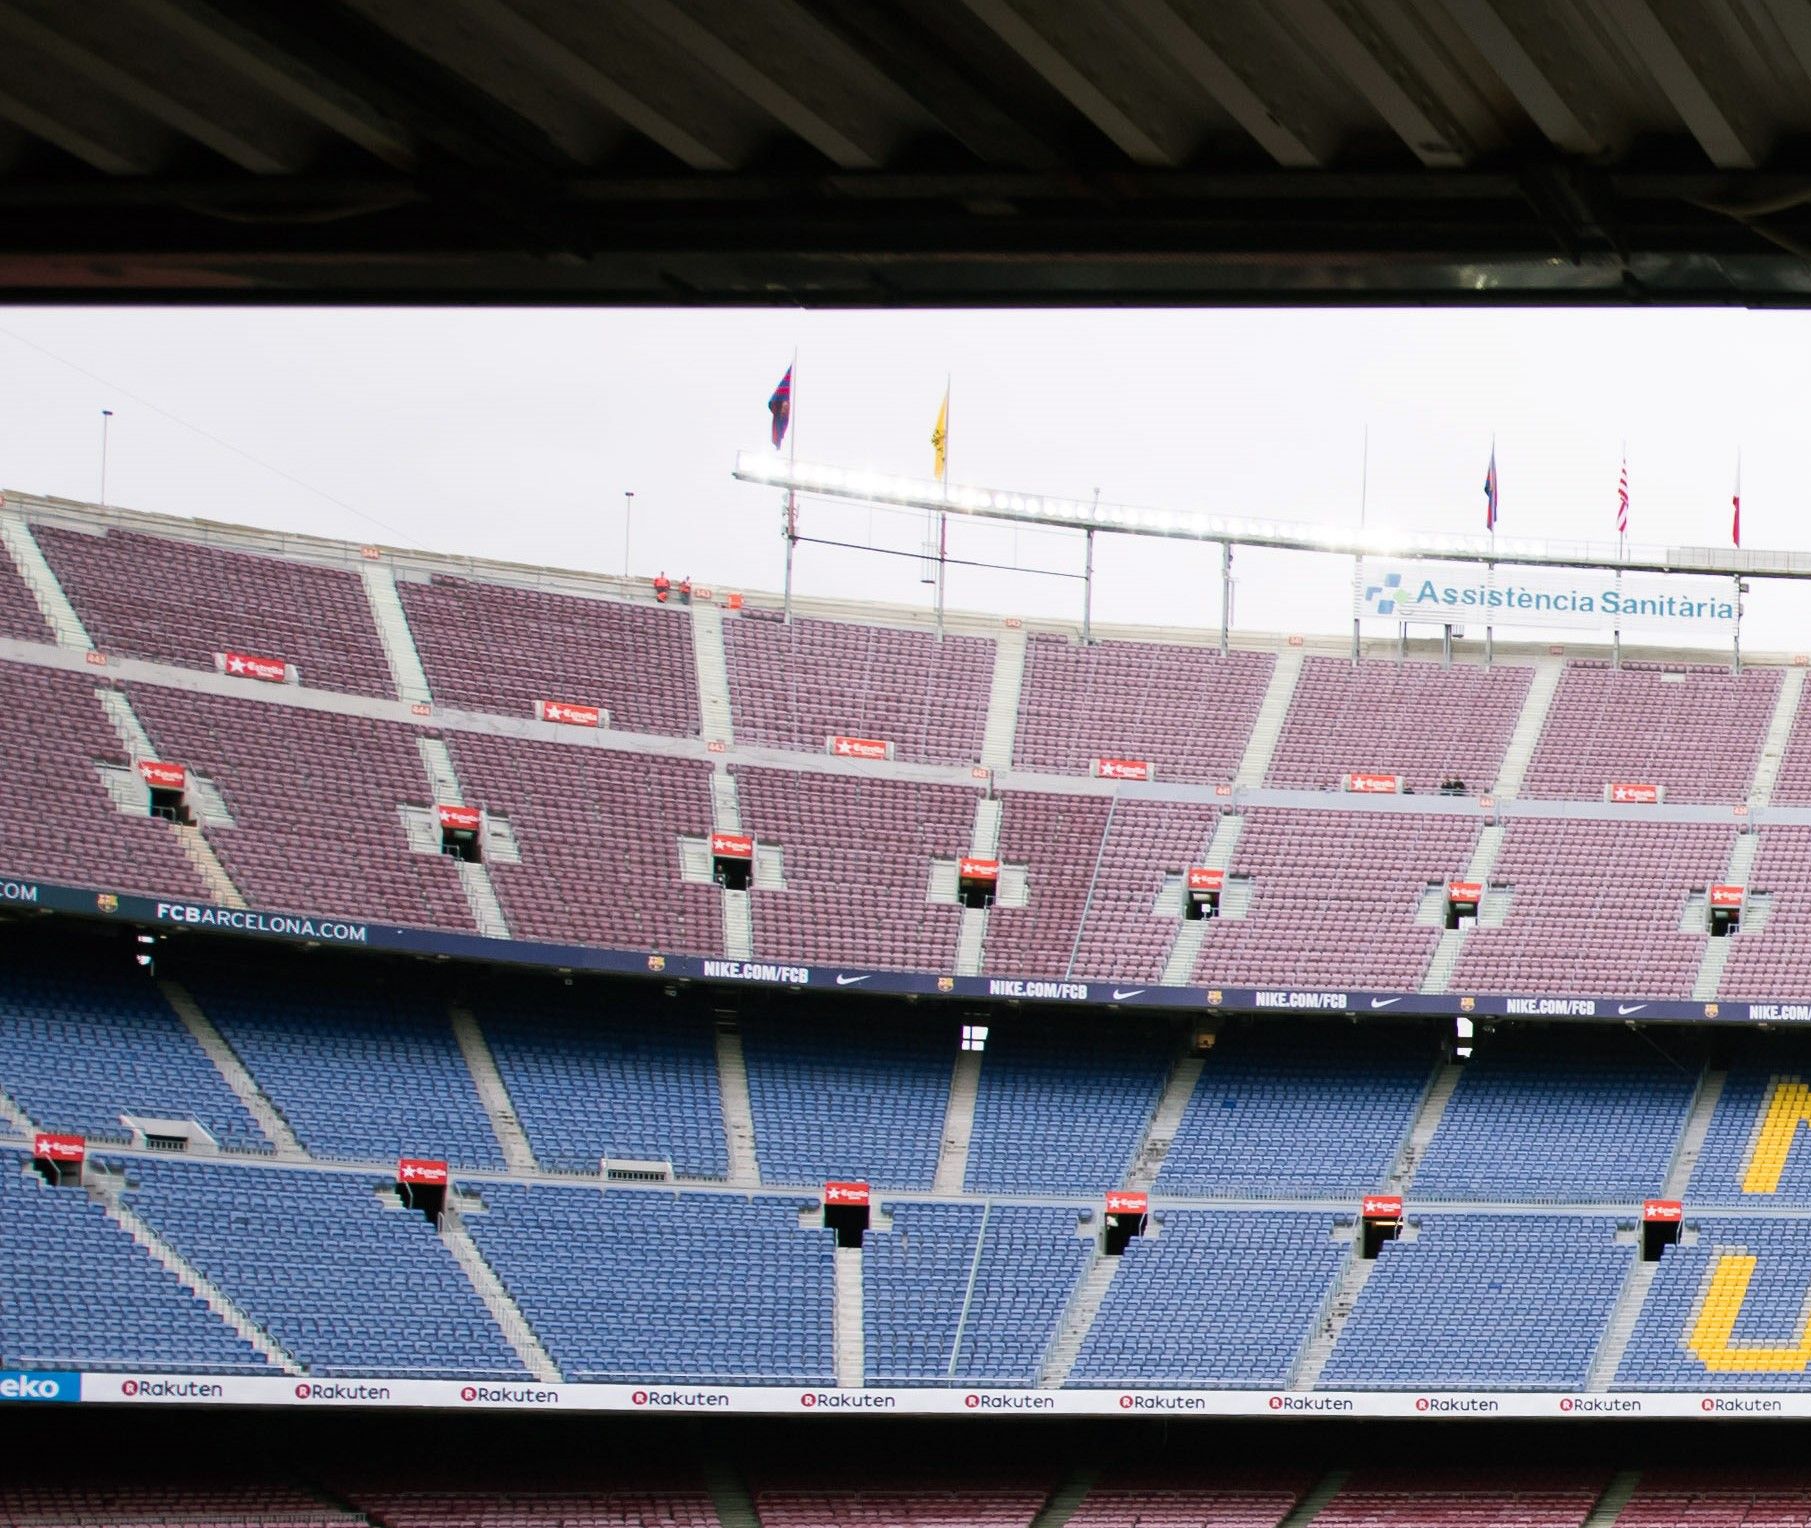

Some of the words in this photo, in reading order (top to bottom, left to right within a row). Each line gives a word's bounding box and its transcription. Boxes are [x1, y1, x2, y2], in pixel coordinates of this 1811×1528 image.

[1416, 580, 1595, 614] Assistència
[1601, 590, 1733, 620] Sanitària
[704, 961, 808, 984] NIKE.COM/FCB
[990, 979, 1087, 999] NIKE.COM/FCB
[1256, 992, 1347, 1009] NIKE.COM/FCB
[1507, 997, 1595, 1016] NIKE.COM/FCB
[139, 1381, 222, 1396] Rakuten
[310, 1384, 389, 1399] Rakuten
[479, 1388, 558, 1402] Rakuten
[649, 1392, 728, 1405] Rakuten
[818, 1394, 895, 1407] Rakuten
[981, 1395, 1053, 1408] Rakuten
[1135, 1396, 1205, 1408] Rakuten
[1284, 1397, 1352, 1410] Rakuten
[1431, 1398, 1498, 1411] Rakuten
[1575, 1399, 1641, 1411] Rakuten
[1716, 1399, 1781, 1411] Rakuten
